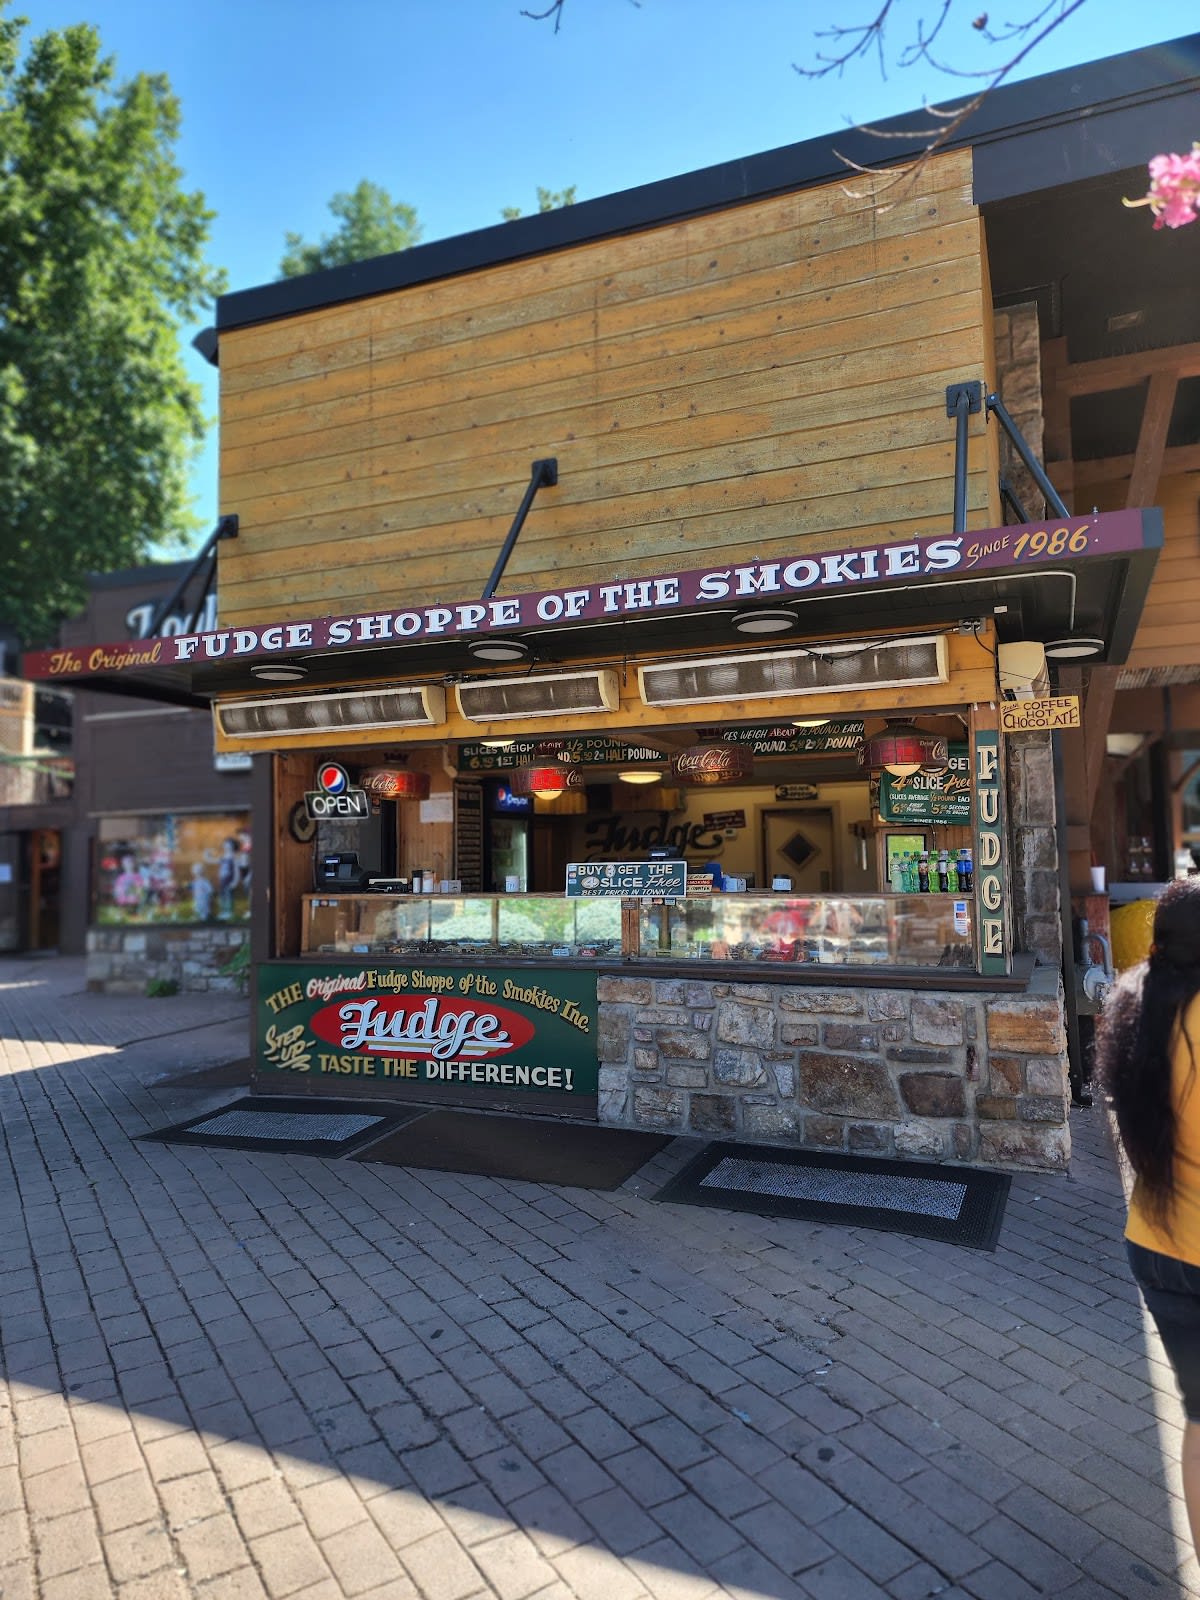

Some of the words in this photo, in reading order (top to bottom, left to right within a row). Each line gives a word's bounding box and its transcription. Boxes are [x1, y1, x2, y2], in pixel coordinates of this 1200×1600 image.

[49, 653, 82, 674] The
[88, 641, 162, 671] Original
[174, 624, 312, 661] FUDGE
[326, 599, 521, 647] SHOPPE
[536, 590, 590, 622] OF
[599, 577, 679, 613] THE
[696, 536, 964, 600] SMOKIES
[966, 535, 1010, 568] SINCE
[1013, 525, 1089, 559] 1986
[1023, 698, 1072, 710] COFFEE
[1003, 706, 1078, 729] CHOCOLATE
[1026, 709, 1054, 719] HOT
[740, 729, 768, 740] WEIGH
[768, 727, 797, 738] ABOUT
[842, 723, 865, 734] EACH
[463, 746, 498, 756] SLICES
[678, 749, 733, 771] Coca-Cola
[913, 776, 944, 790] SLICE
[312, 796, 361, 814] OPEN
[977, 745, 1003, 955] FUDGE
[578, 865, 603, 876] BUY
[617, 865, 640, 875] GET
[648, 864, 673, 874] THE
[600, 877, 643, 888] SLICE
[644, 874, 682, 888] Free
[581, 889, 602, 897] BEST
[265, 982, 304, 1014] THE
[306, 971, 367, 1001] Original
[367, 969, 408, 994] Fudge
[411, 969, 455, 993] Shoppe
[459, 973, 474, 994] of
[475, 974, 498, 995] the
[502, 978, 560, 1013] Smokies
[560, 999, 590, 1033] Inc.
[339, 997, 508, 1059] Fudge
[318, 1053, 376, 1076] TASTE
[381, 1057, 418, 1078] THE
[426, 1061, 574, 1091] DIFFERENCE!
